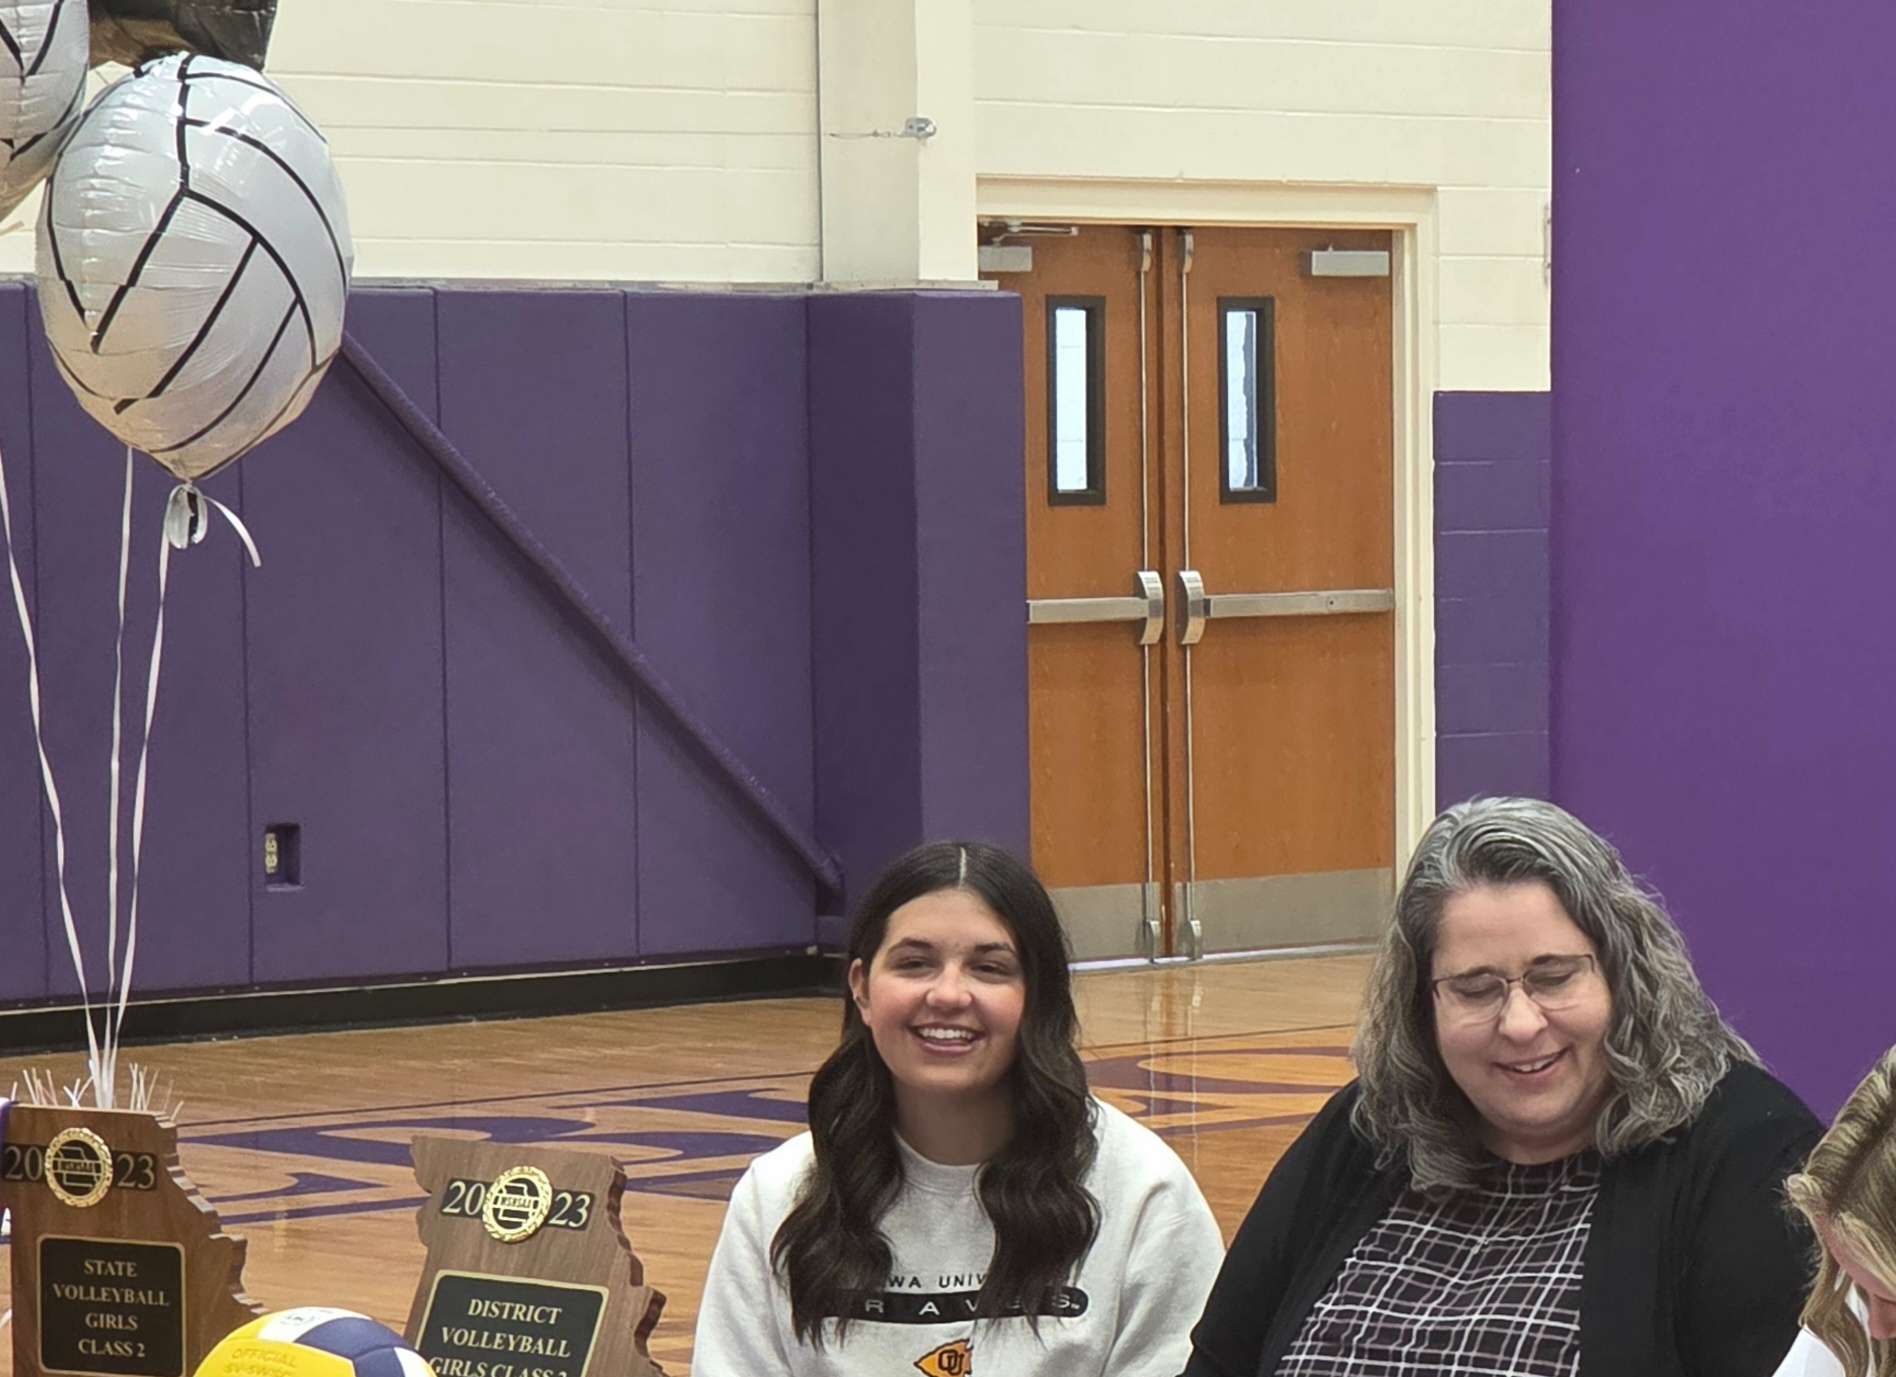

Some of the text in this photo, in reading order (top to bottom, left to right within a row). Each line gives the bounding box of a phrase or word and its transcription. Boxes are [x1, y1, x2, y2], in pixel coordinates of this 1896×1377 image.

[83, 1259, 137, 1277] STATE
[53, 1283, 169, 1306] VOLLEYBALL
[85, 1313, 138, 1330] GIRLS
[468, 1299, 562, 1325] DISTRICT
[78, 1338, 146, 1357] CLASS 2
[441, 1327, 571, 1358] VOLLEYBALL
